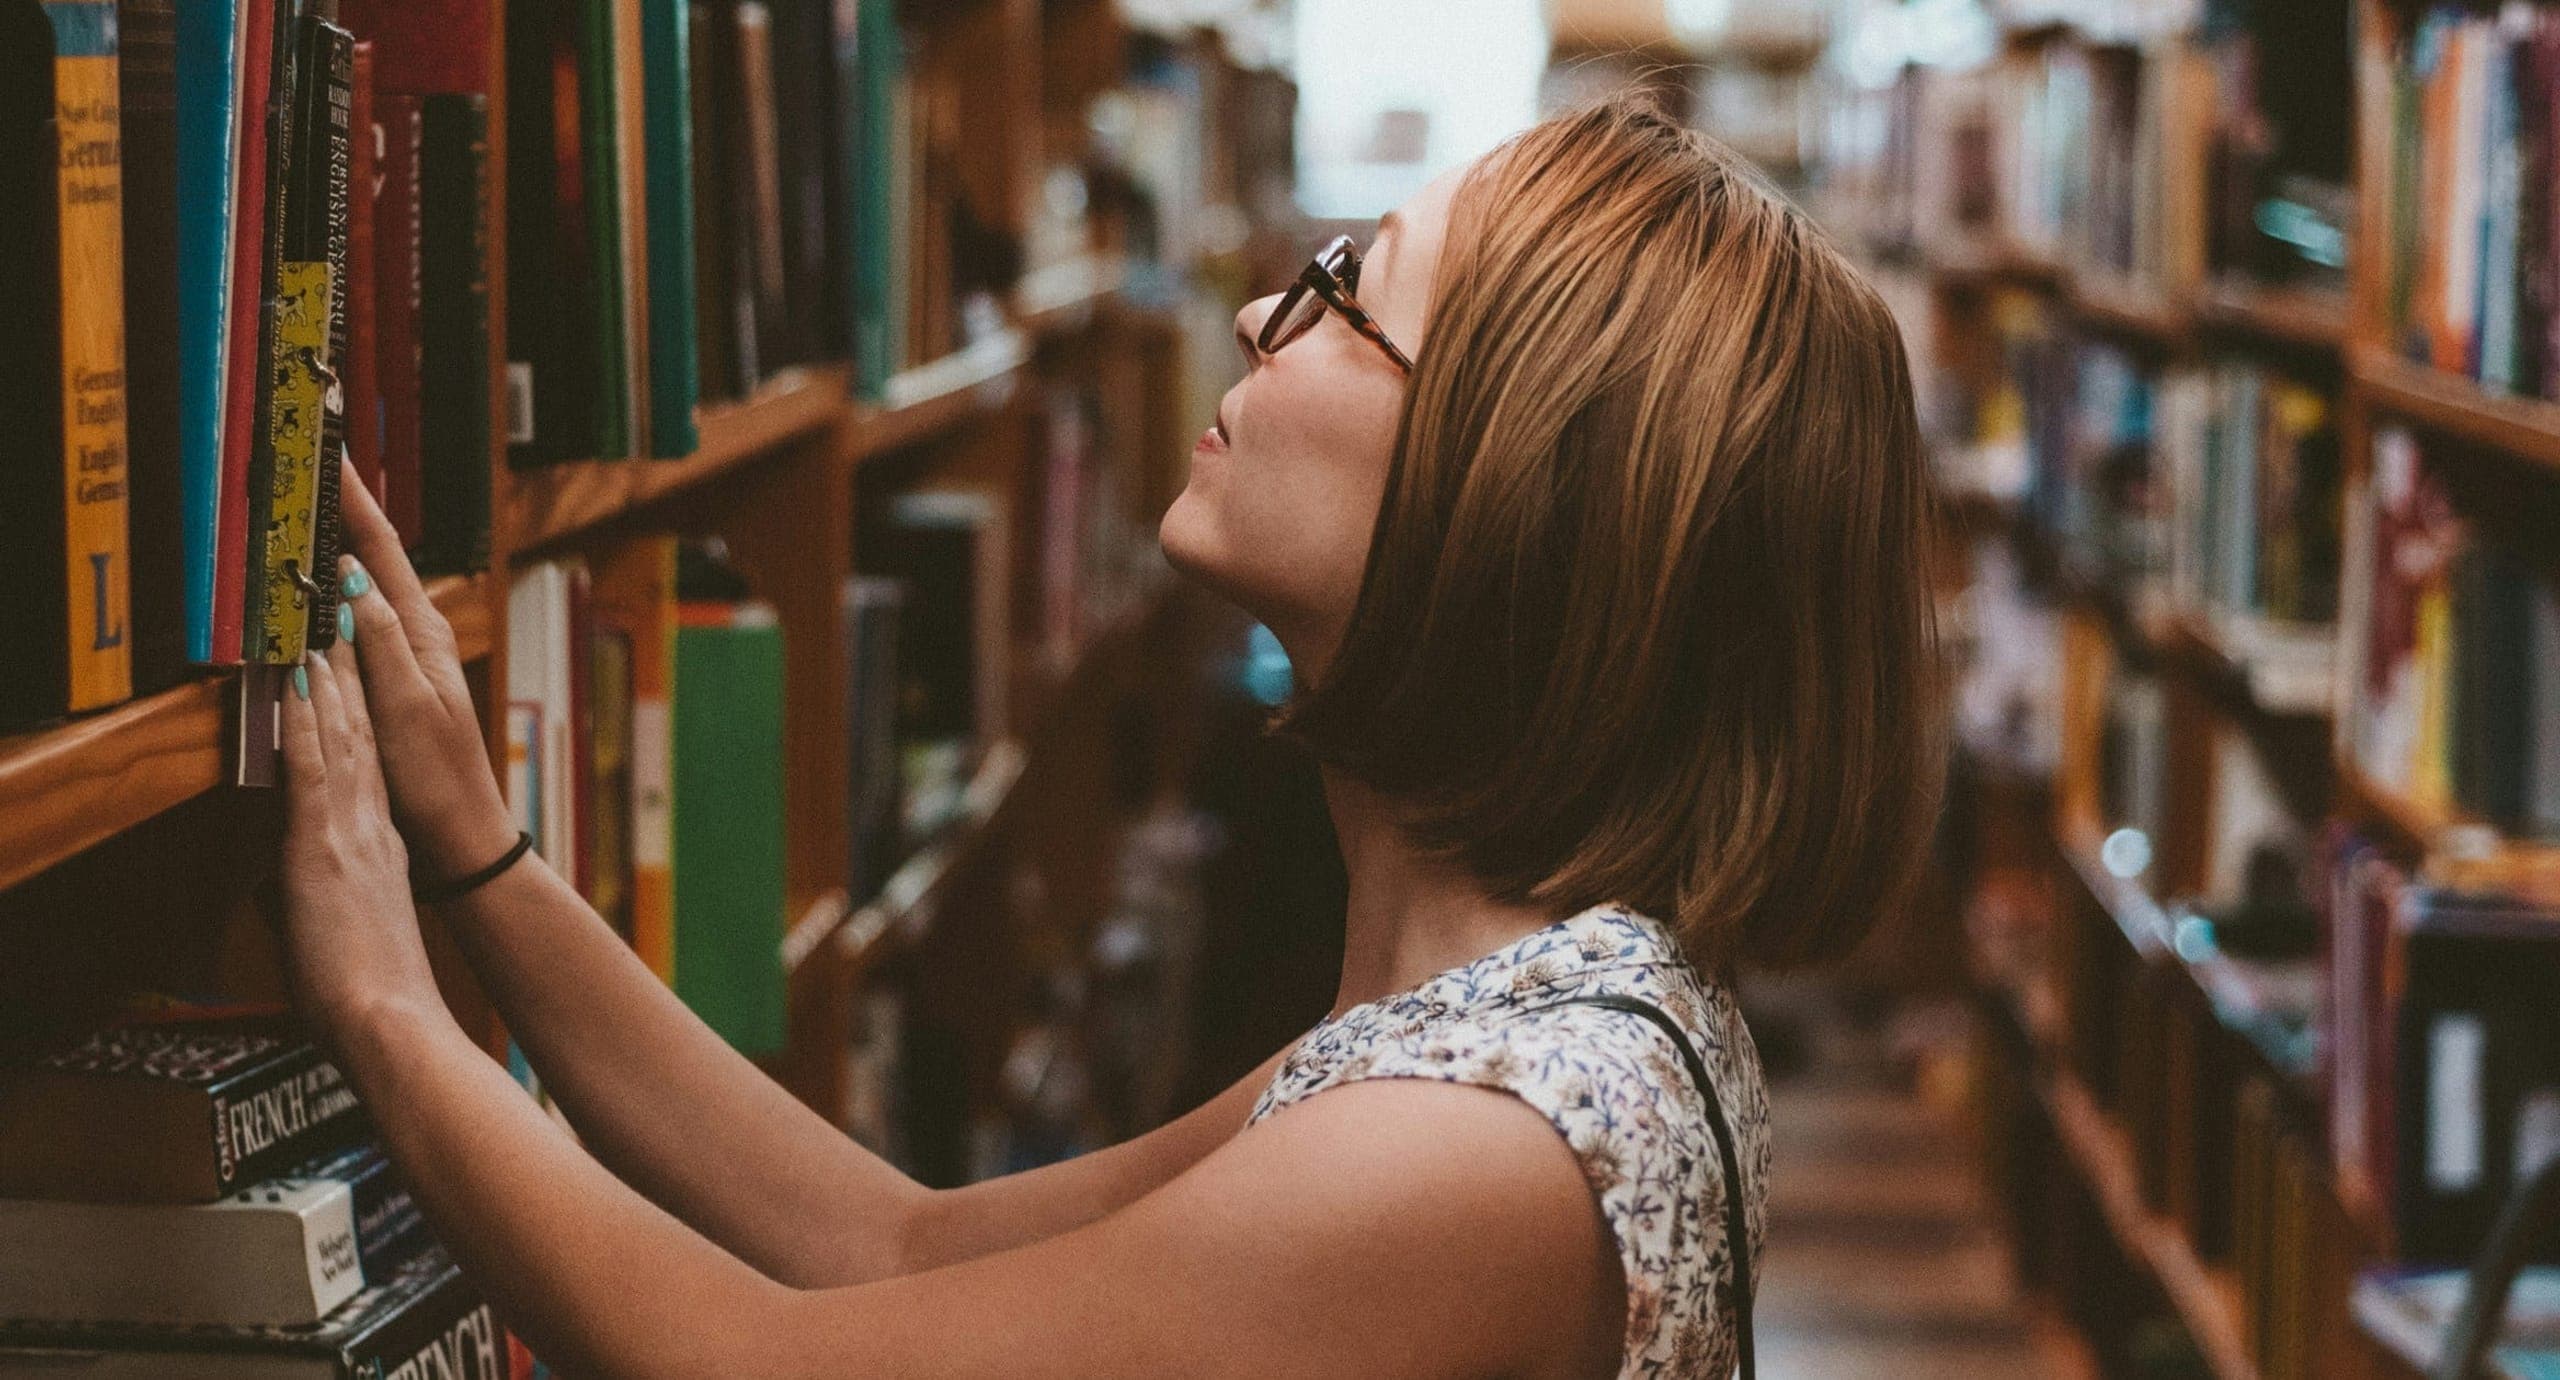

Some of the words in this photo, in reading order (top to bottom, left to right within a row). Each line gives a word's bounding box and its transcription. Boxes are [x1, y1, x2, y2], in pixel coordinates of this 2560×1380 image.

[335, 138, 349, 324] GERMAN-ENGLISH
[90, 552, 122, 653] L
[229, 1074, 308, 1162] FRENCH
